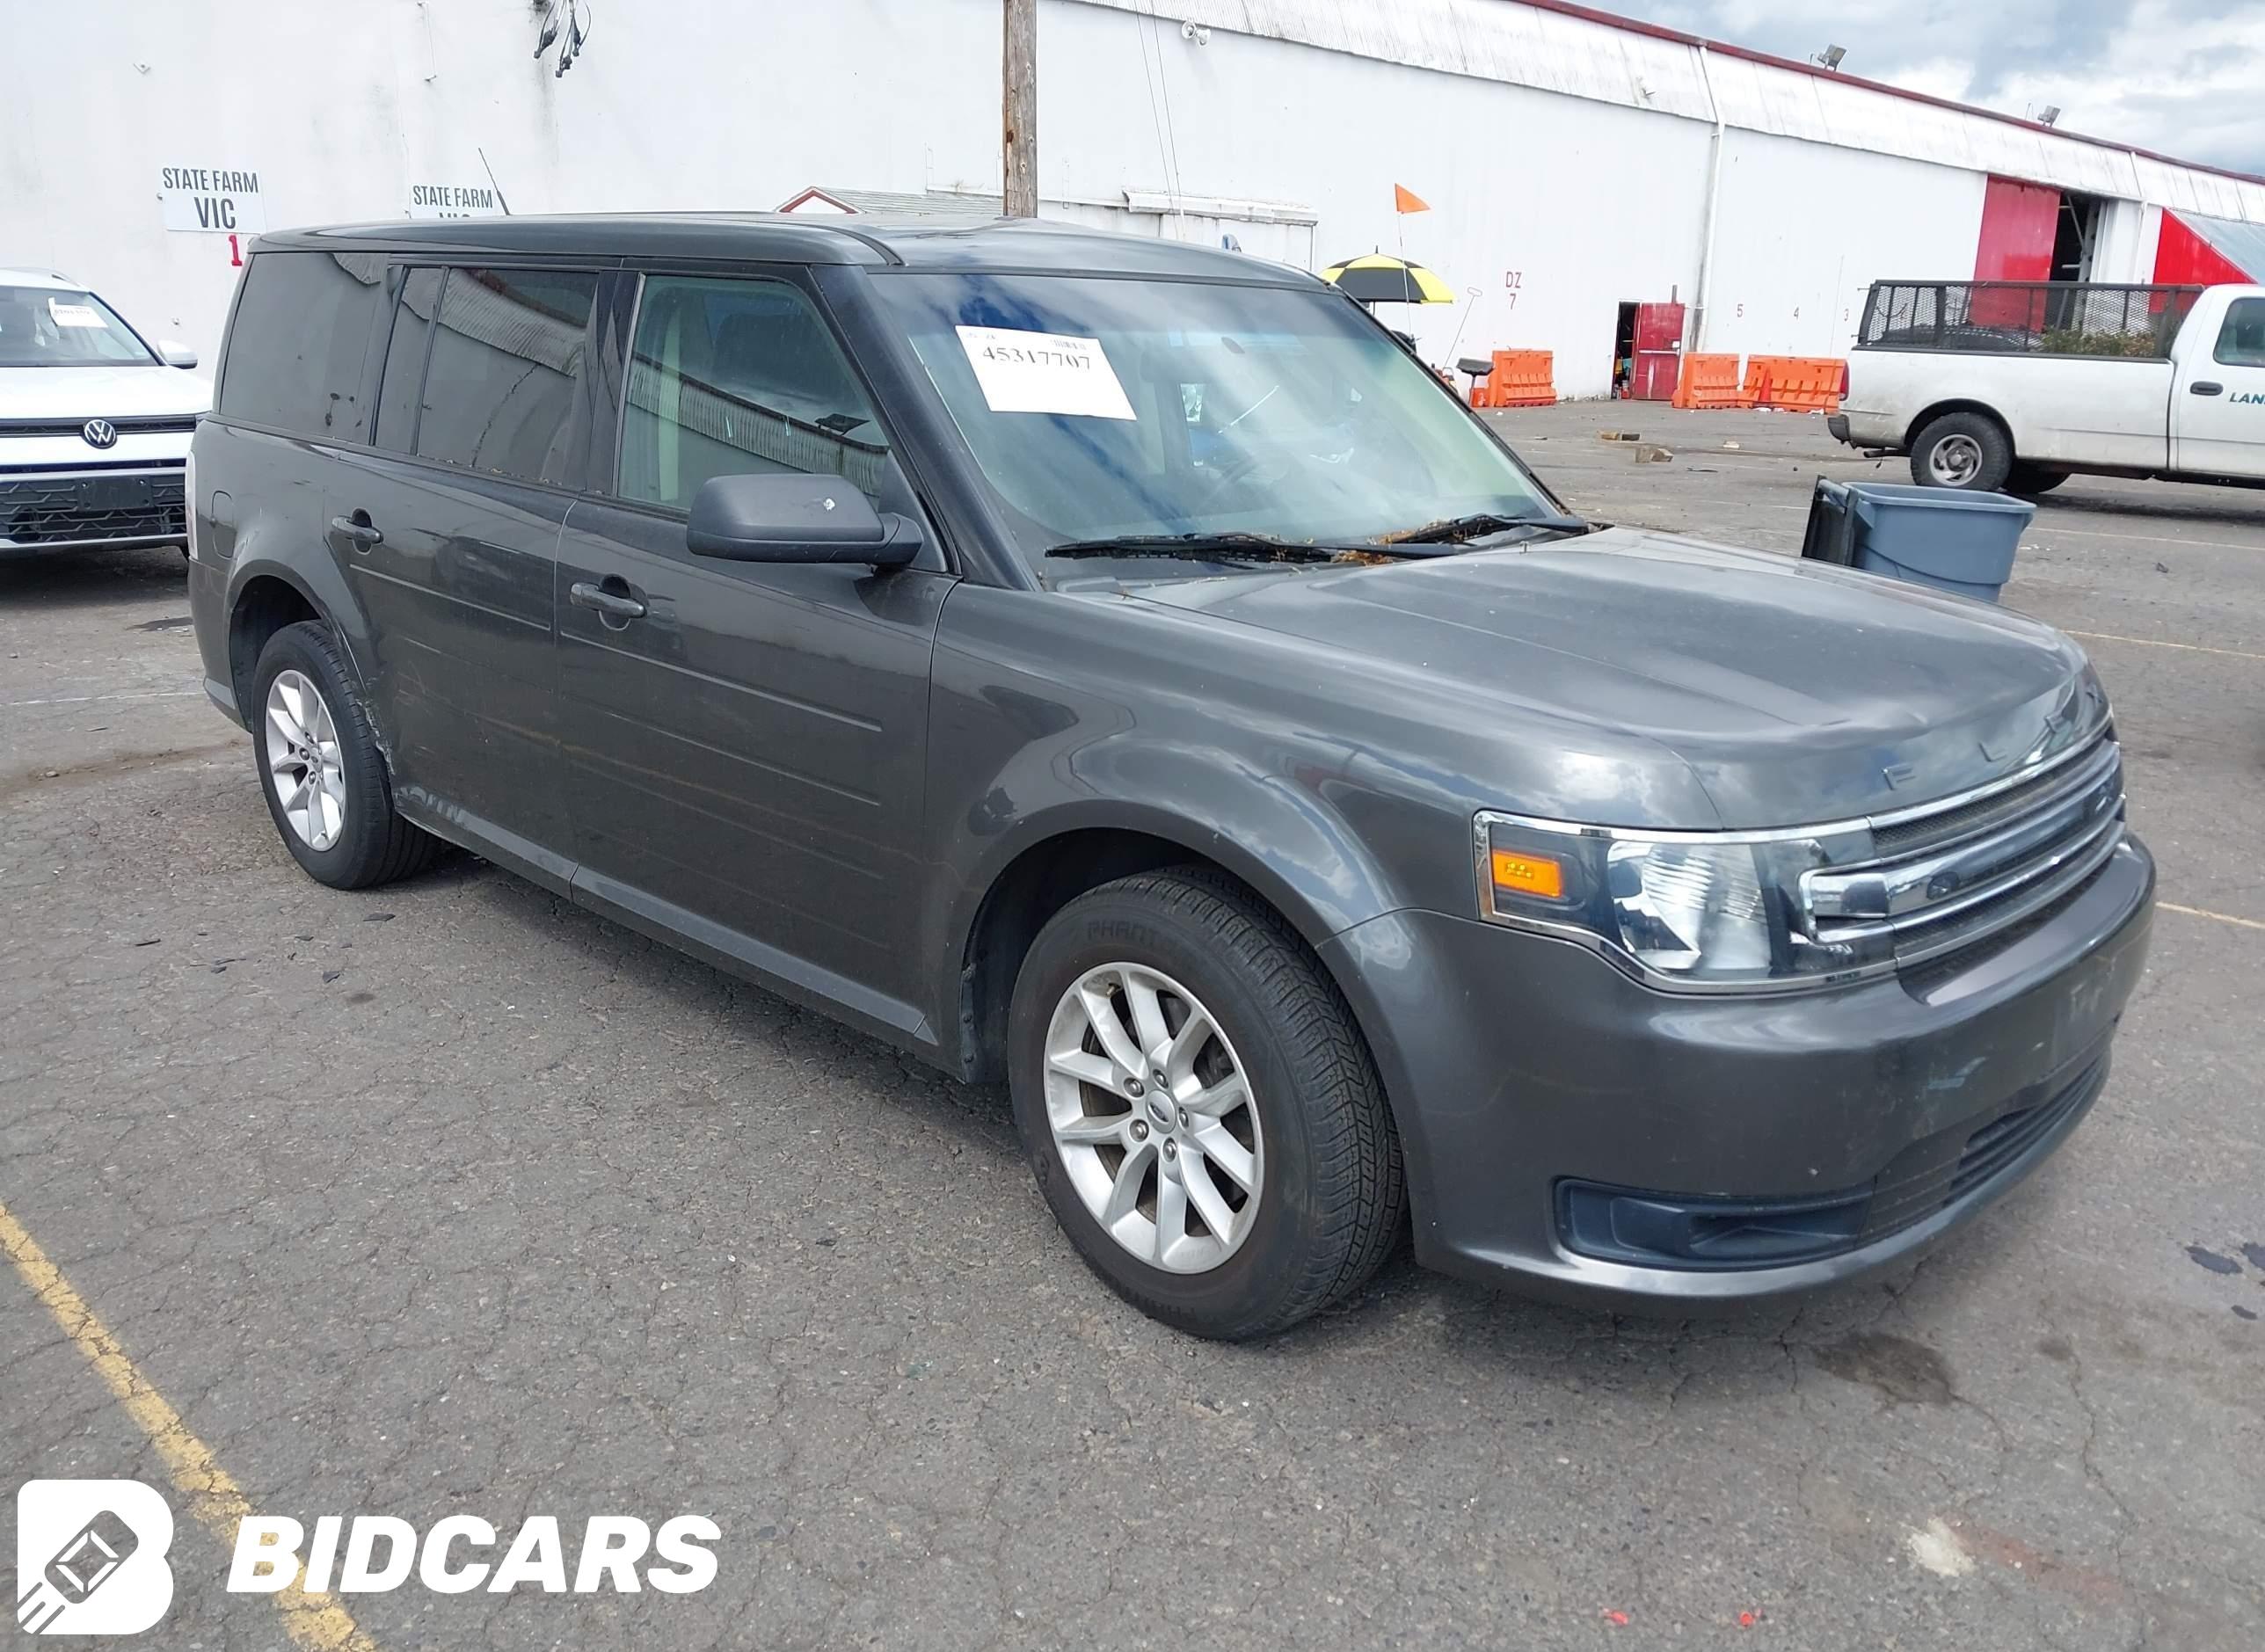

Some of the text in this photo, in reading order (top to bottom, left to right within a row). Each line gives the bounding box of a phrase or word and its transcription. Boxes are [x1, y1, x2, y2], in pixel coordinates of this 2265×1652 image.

[162, 167, 259, 193] STATE FARM
[412, 185, 493, 208] STATE FARM
[193, 196, 237, 229] VIC
[229, 234, 243, 266] 1
[1509, 292, 1517, 310] 7
[1737, 302, 1744, 317] 5
[1793, 306, 1799, 320] 4
[983, 346, 1091, 370] 45317707
[2228, 391, 2265, 405] LAN
